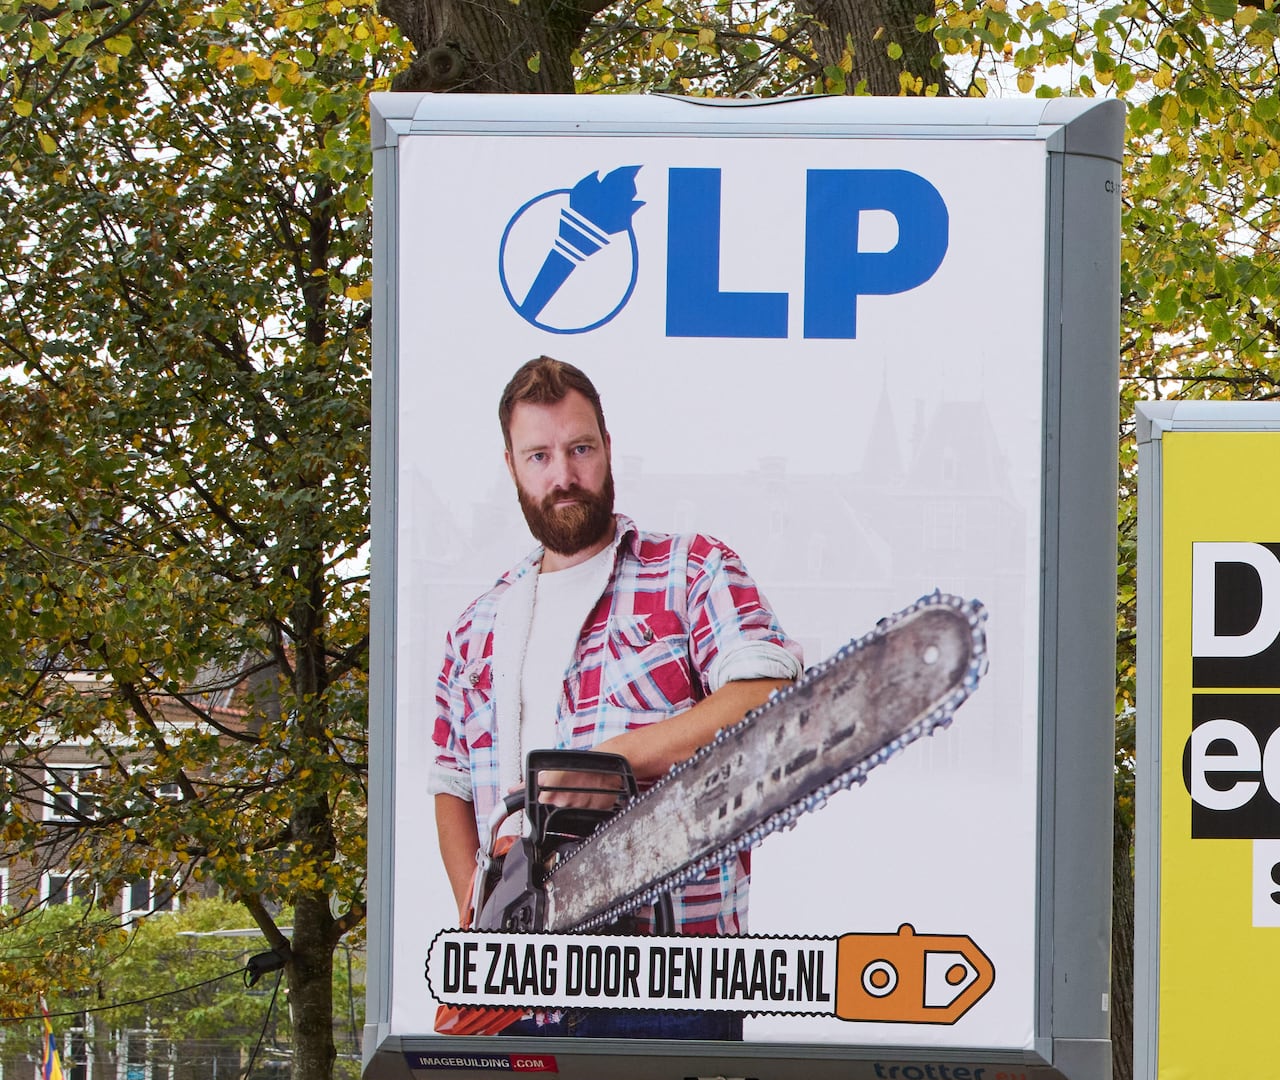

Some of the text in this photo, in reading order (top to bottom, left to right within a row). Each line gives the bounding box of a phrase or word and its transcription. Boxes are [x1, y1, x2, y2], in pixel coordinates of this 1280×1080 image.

[665, 167, 950, 339] LP
[443, 941, 831, 1002] DE ZAAG DOOR DEN HAAG.NL
[419, 1057, 510, 1068] IMAGEBUILDING
